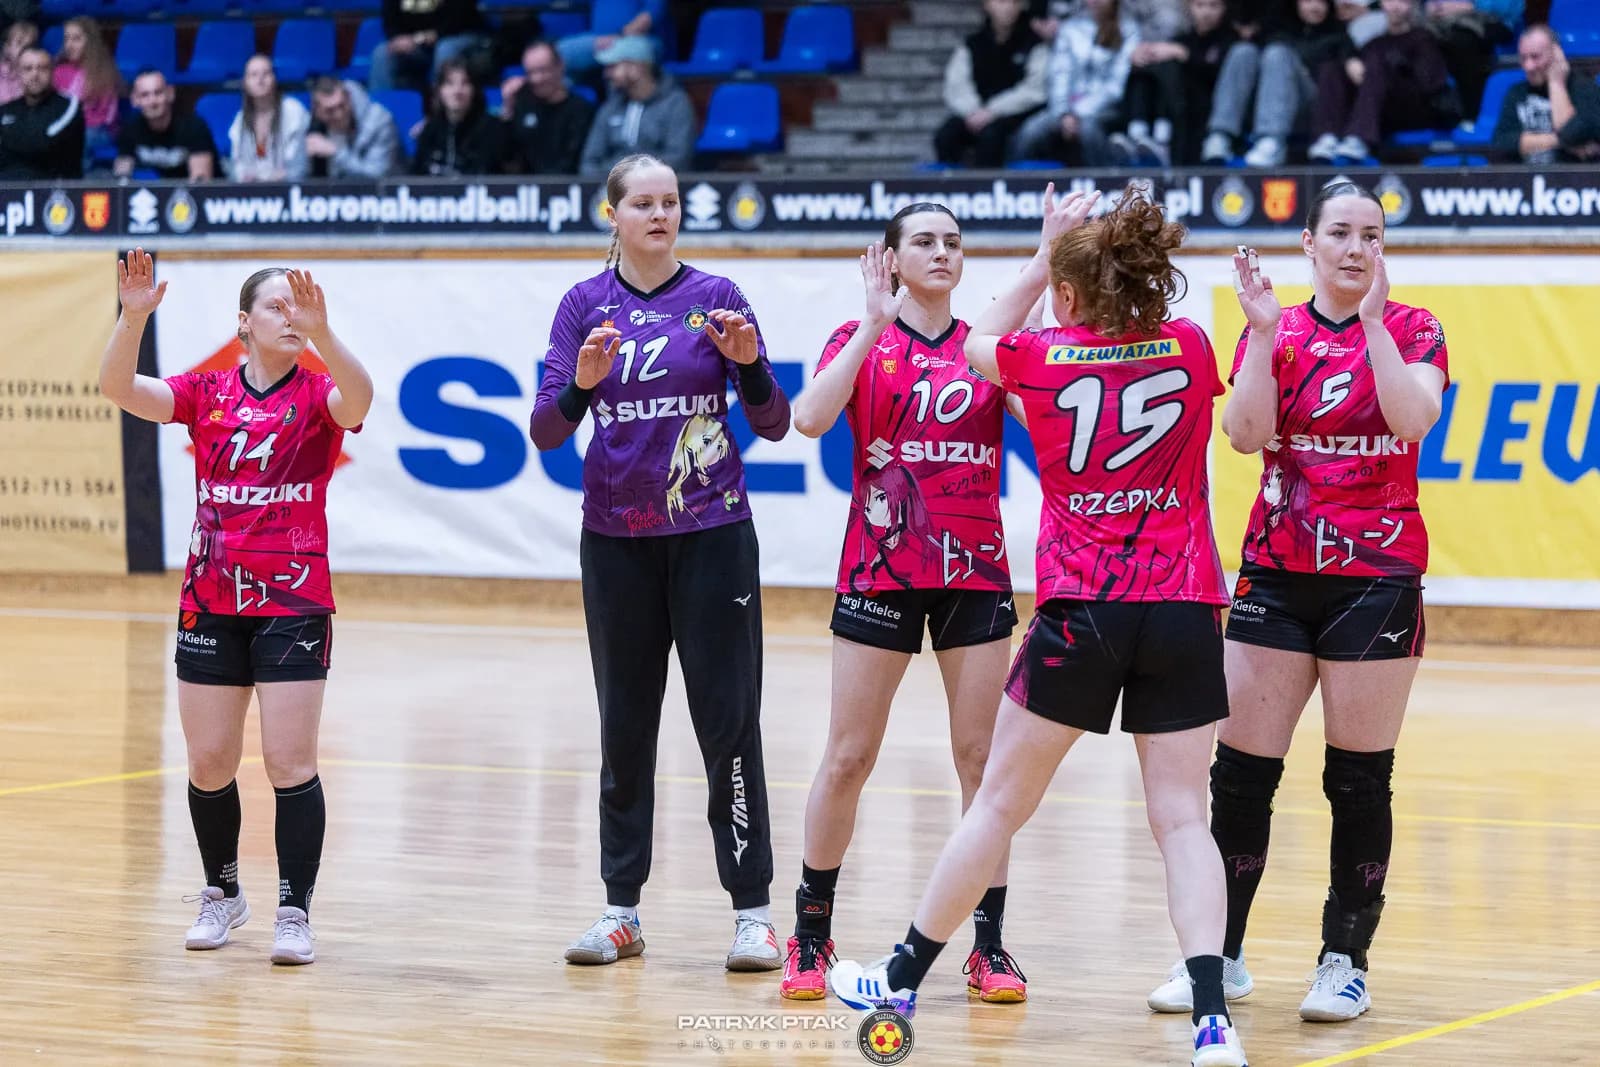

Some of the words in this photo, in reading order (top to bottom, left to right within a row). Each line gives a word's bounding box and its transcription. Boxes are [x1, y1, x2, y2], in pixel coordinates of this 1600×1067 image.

[204, 185, 581, 233] www.koronahandball.pl
[1421, 174, 1600, 216] www.kor
[618, 335, 669, 385] 12
[1077, 341, 1172, 361] LEWIATAN
[616, 394, 719, 423] SUZUKI
[911, 379, 974, 425] 10
[1311, 370, 1354, 420] 5
[1054, 367, 1191, 475] 15
[228, 429, 278, 472] 14
[901, 440, 996, 468] SUZUKI
[1290, 433, 1408, 456] SUZUKI
[213, 482, 313, 506] SUZUKI
[1069, 486, 1181, 515] RZEPKA
[1315, 515, 1404, 573] ビューン
[233, 561, 310, 614] ビューン
[863, 599, 902, 620] Kielce
[1234, 599, 1266, 615] Kielce
[184, 632, 217, 646] Kielce
